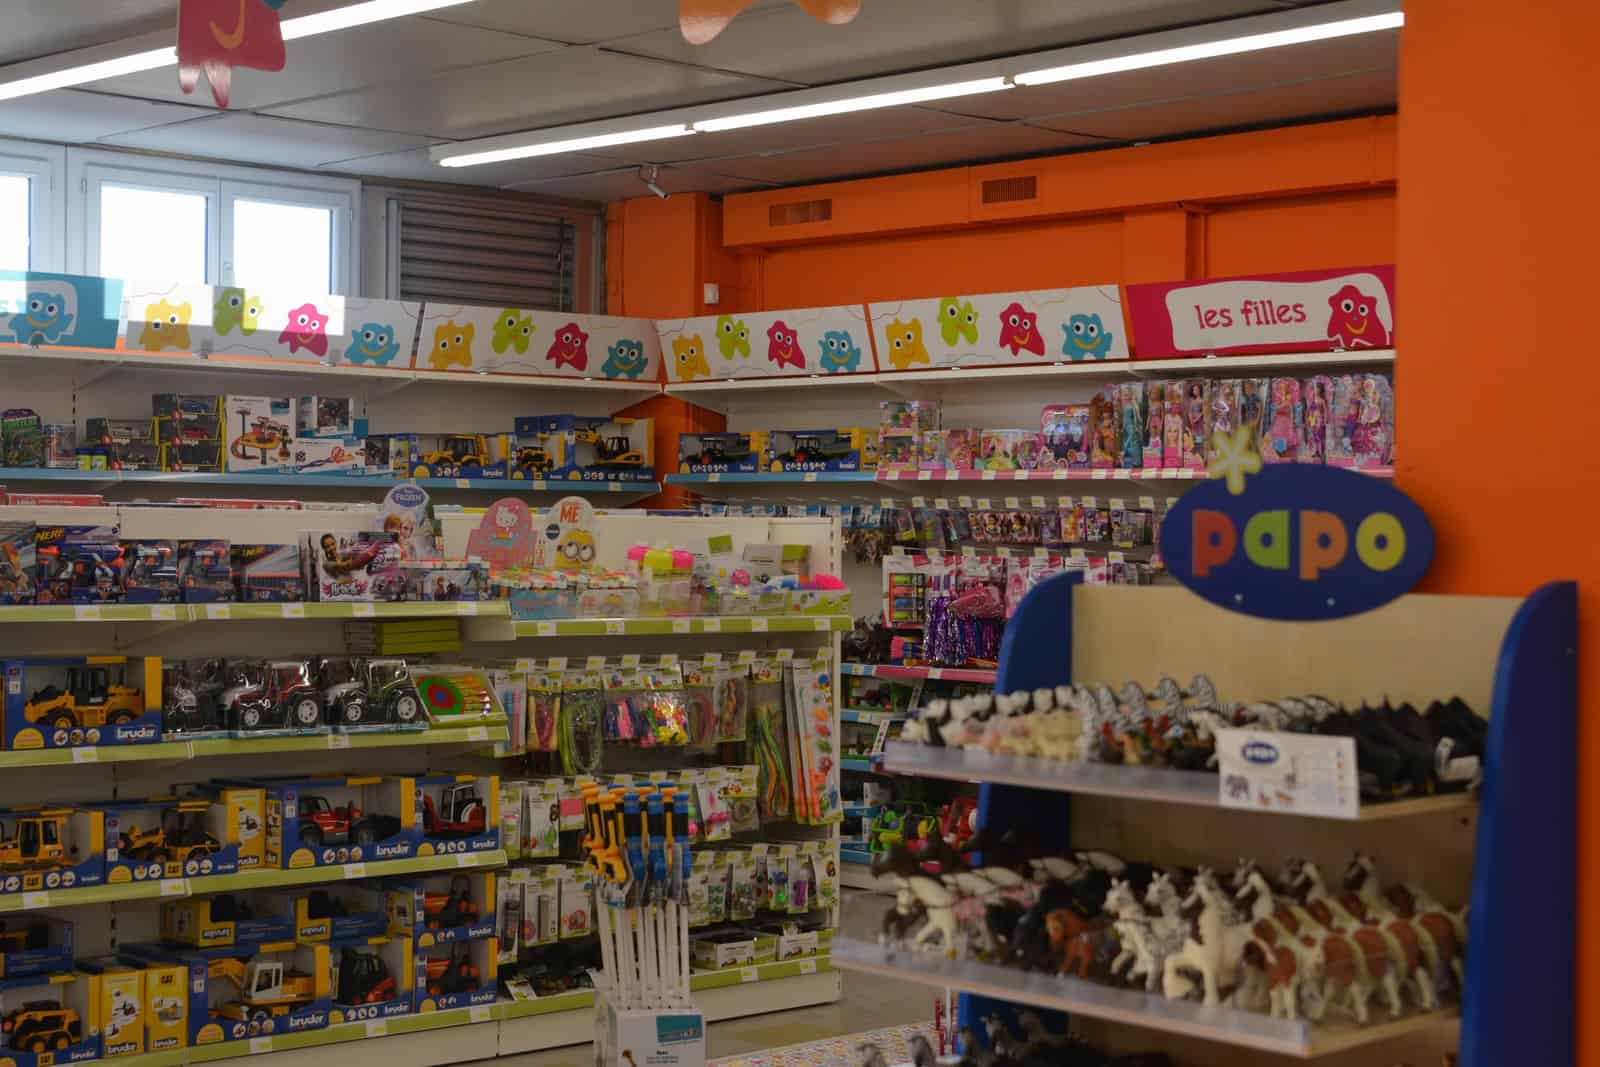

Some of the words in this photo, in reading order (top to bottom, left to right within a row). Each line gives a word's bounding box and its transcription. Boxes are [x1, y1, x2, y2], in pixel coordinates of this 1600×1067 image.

[1194, 304, 1233, 329] les
[1241, 299, 1307, 326] filles
[559, 504, 579, 523] ME
[1192, 509, 1406, 580] papo
[116, 727, 155, 739] bruder
[376, 843, 408, 855] bruder
[289, 1014, 324, 1027] bruder
[107, 1043, 137, 1056] bruder
